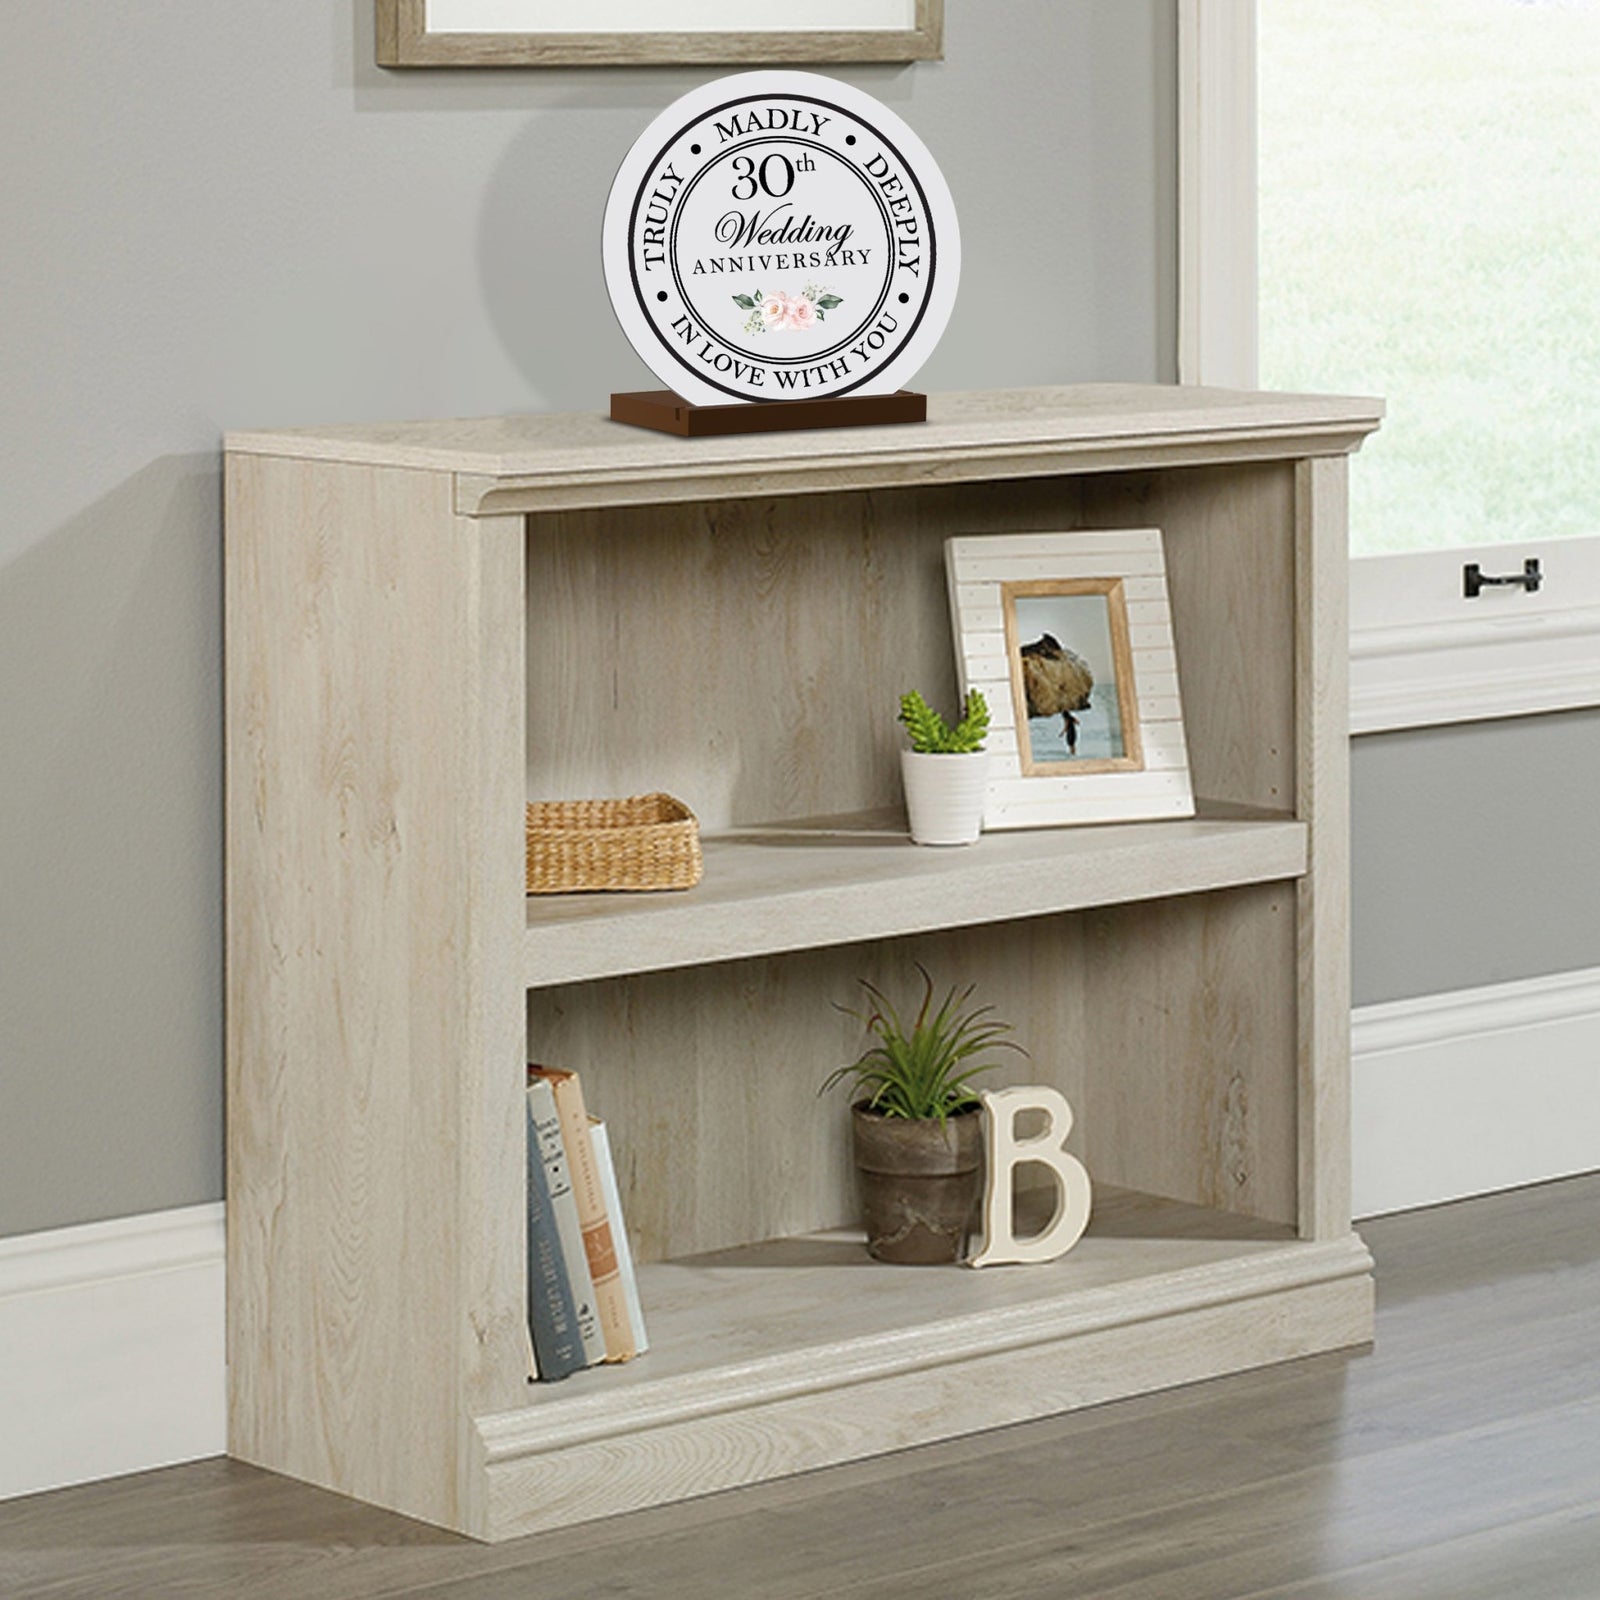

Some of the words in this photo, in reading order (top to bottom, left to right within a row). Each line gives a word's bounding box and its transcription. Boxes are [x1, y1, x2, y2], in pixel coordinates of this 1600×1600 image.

[644, 162, 684, 271] TRULY
[713, 109, 831, 143] MADLY
[863, 152, 920, 277] DEEPLY
[732, 153, 816, 200] 30th
[693, 250, 871, 274] ANNIVERSARY
[715, 203, 854, 257] Wedding
[671, 314, 701, 345] IN
[697, 341, 765, 386] LOVE
[773, 356, 851, 389] WITH
[850, 311, 897, 362] YOU
[967, 1086, 1092, 1267] B
